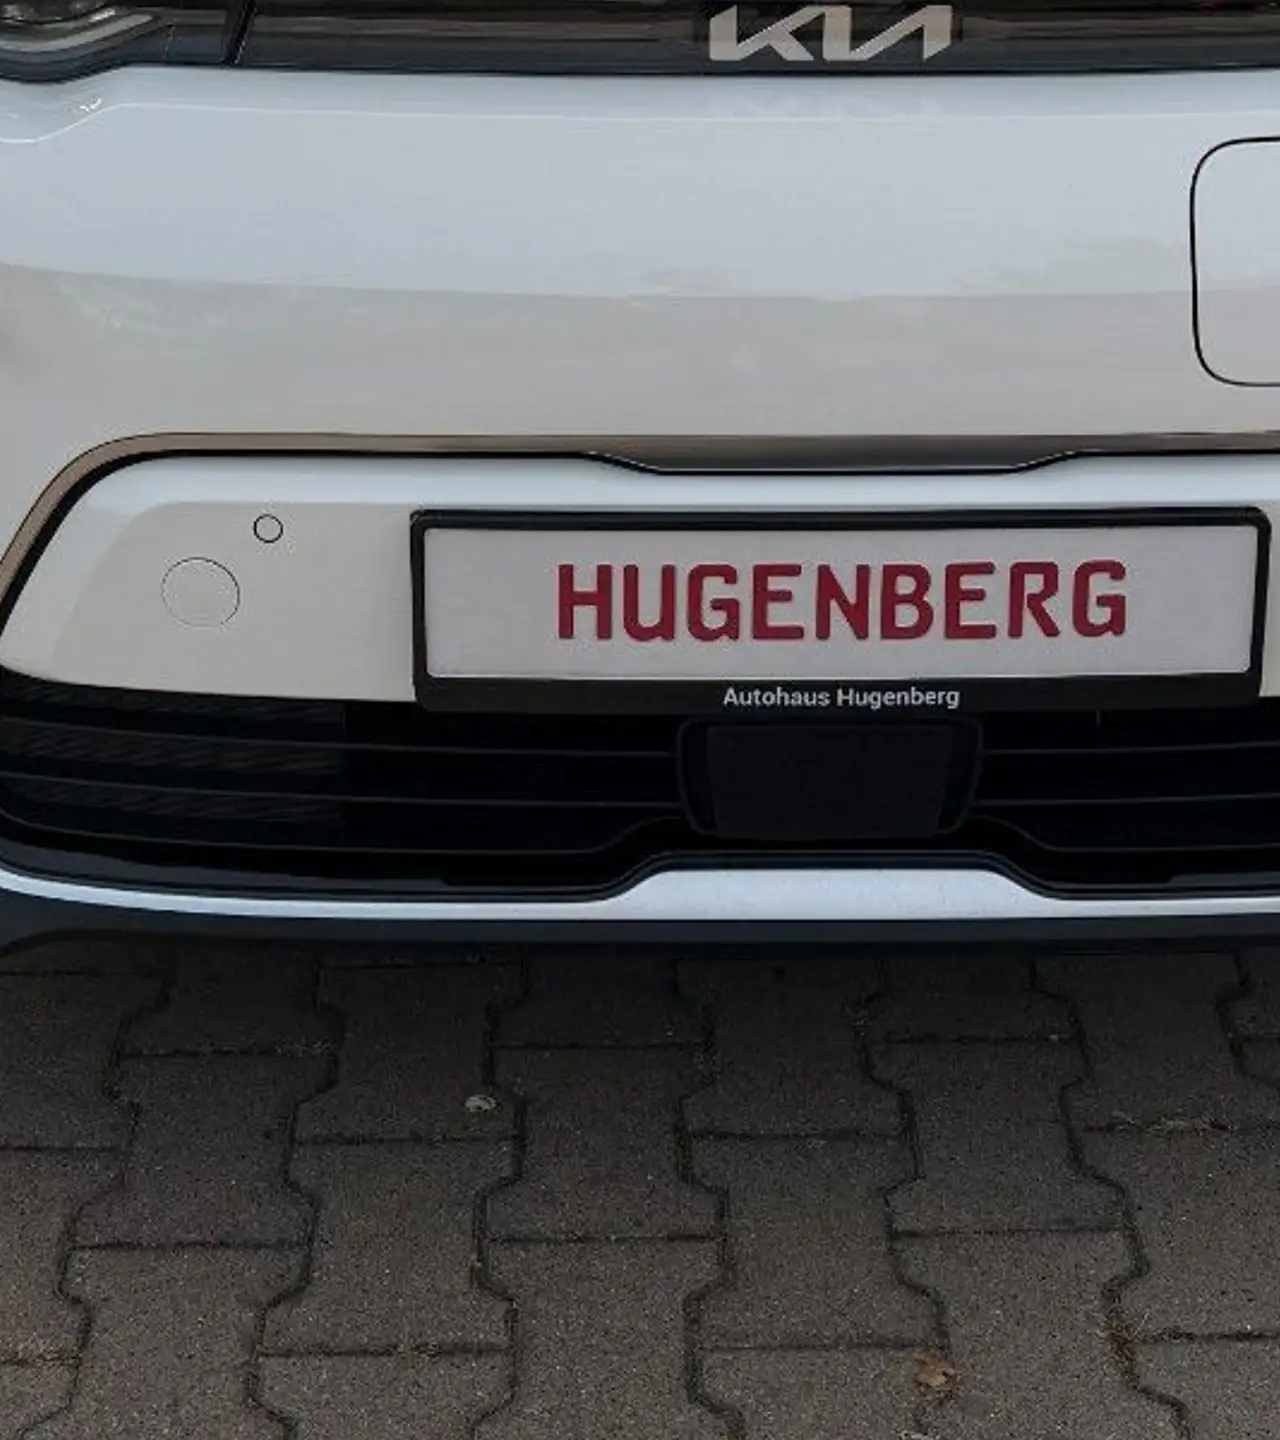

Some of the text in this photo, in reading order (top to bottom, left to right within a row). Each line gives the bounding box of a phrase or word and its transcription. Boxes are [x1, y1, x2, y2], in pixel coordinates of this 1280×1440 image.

[709, 5, 953, 62] KIA
[557, 559, 1127, 641] HUGENBERG
[723, 686, 961, 709] Autohaus Hugenberg
